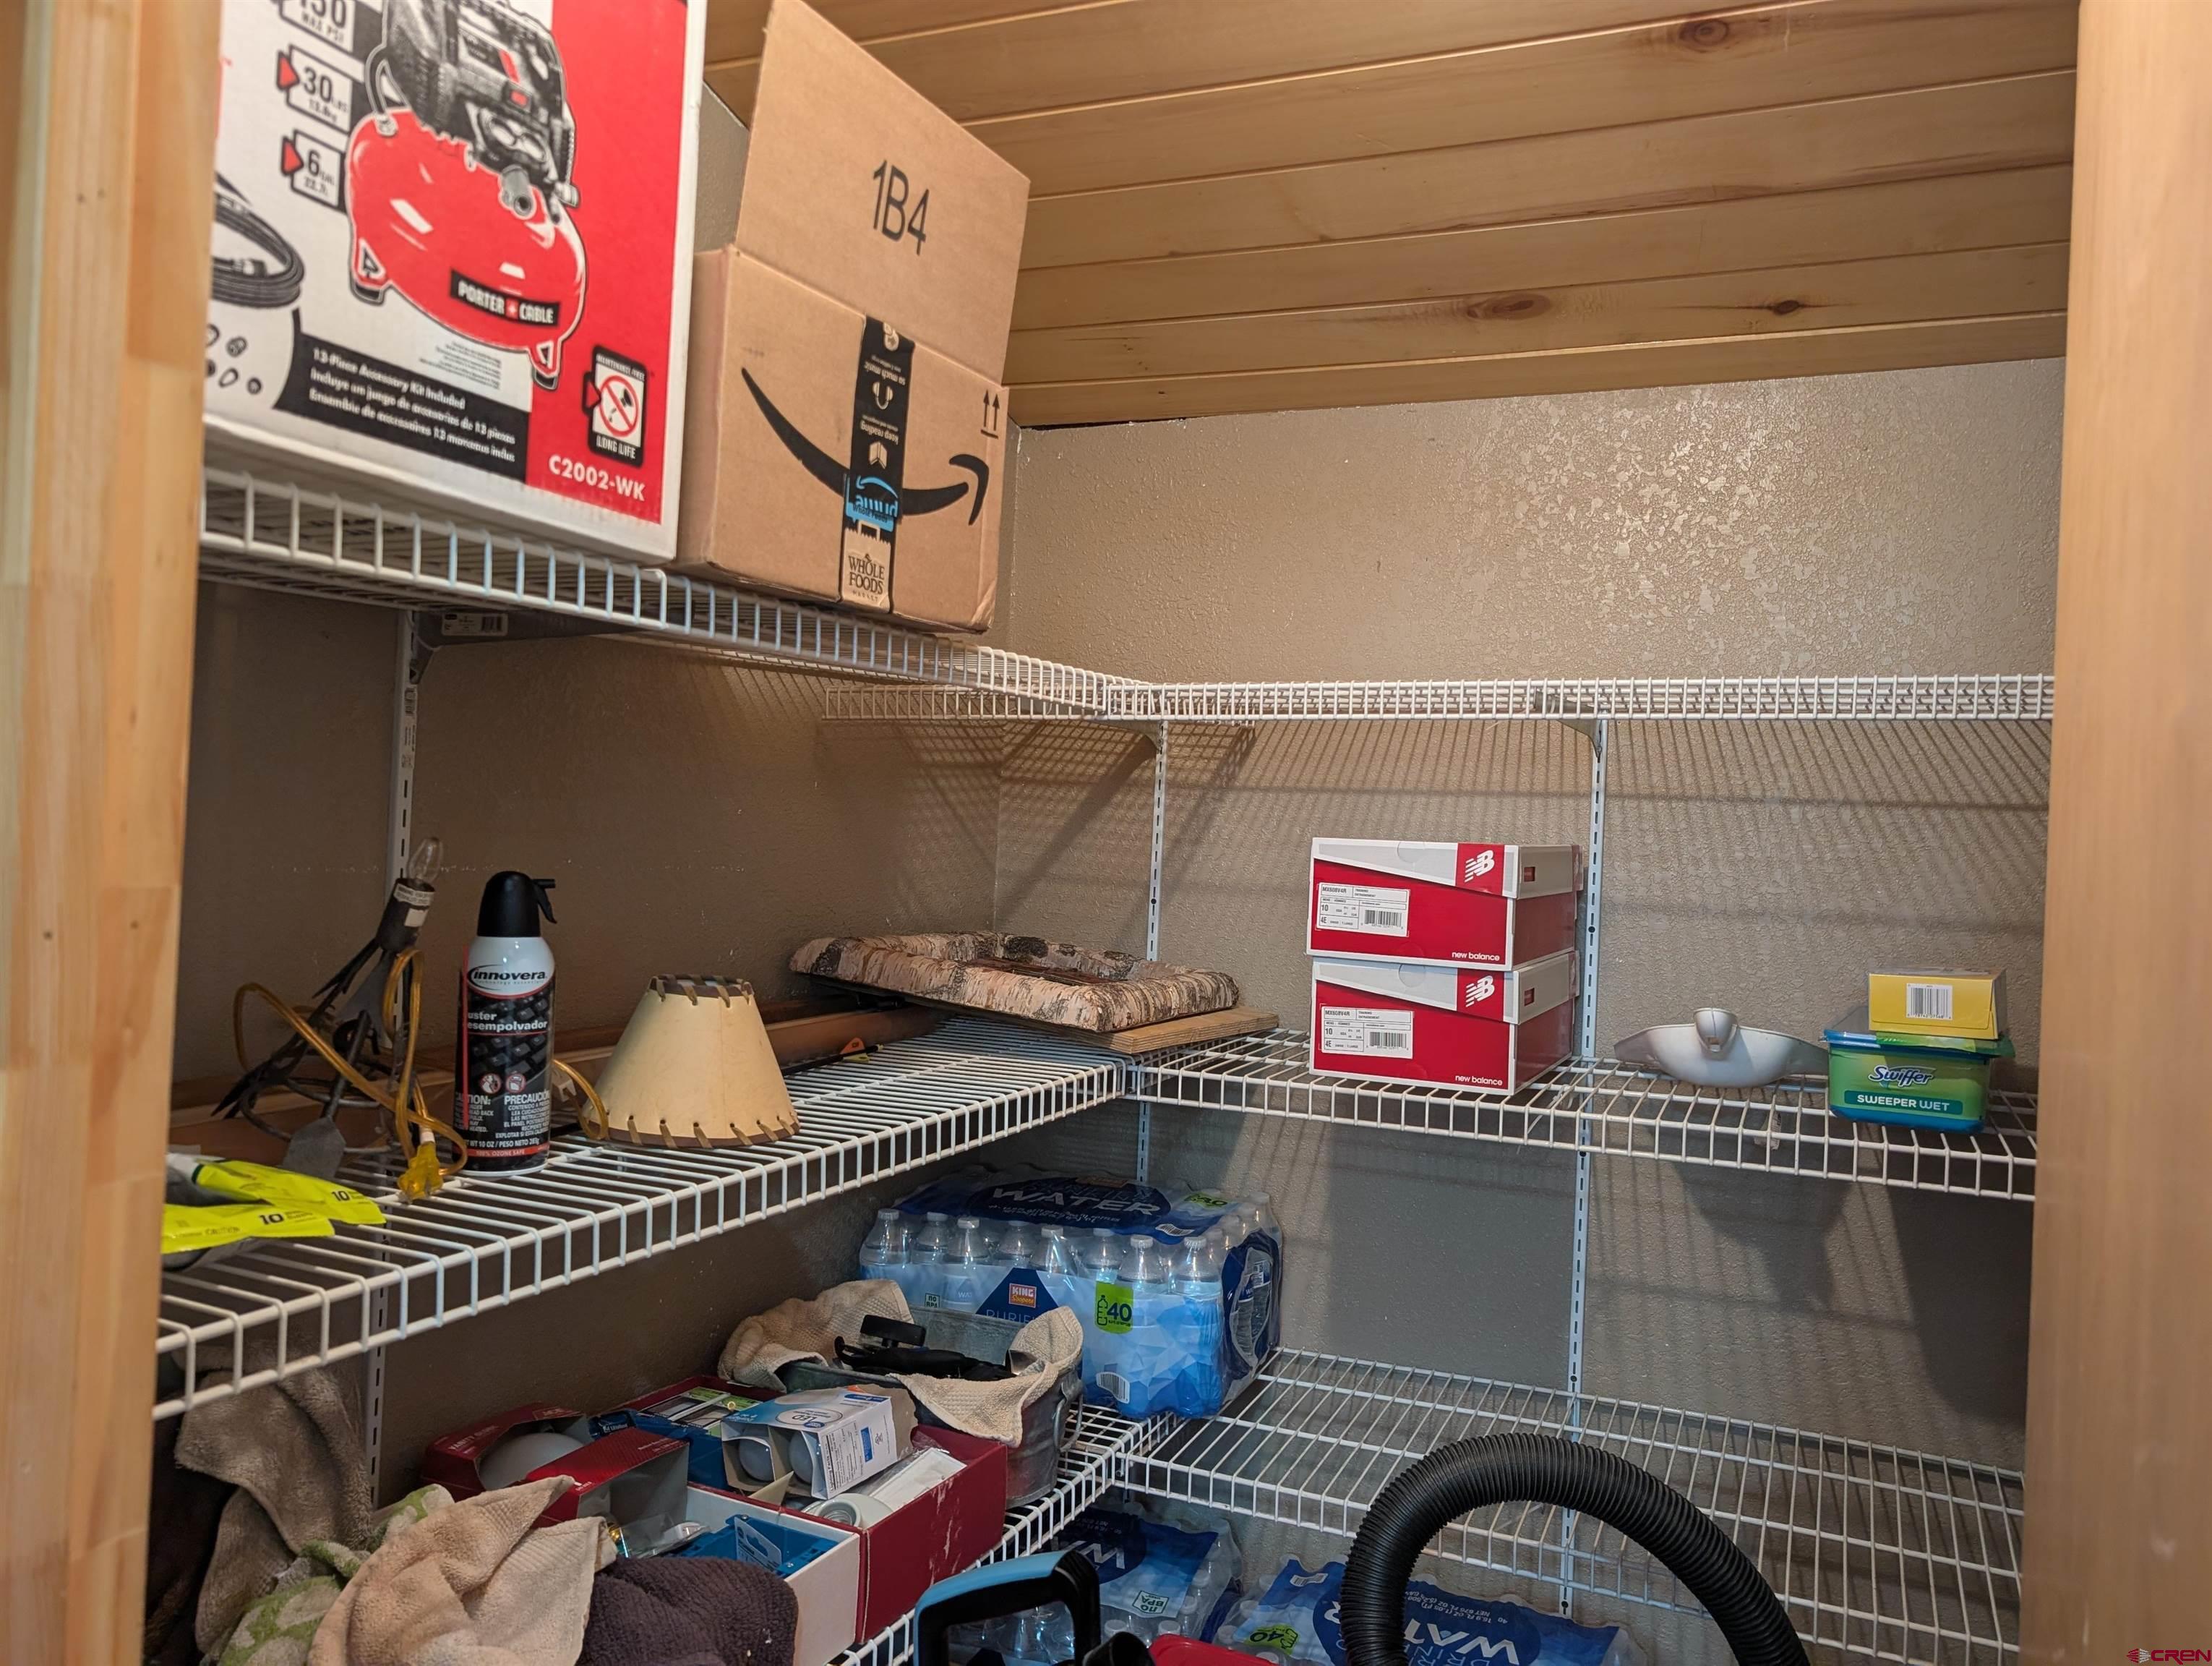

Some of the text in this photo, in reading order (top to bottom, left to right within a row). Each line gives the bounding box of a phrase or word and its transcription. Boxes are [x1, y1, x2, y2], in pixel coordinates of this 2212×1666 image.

[304, 66, 332, 103] 30
[308, 149, 321, 176] 6
[873, 158, 930, 257] 1B4
[458, 280, 554, 324] PORTER CABLE
[864, 361, 880, 375] music
[880, 367, 899, 383] much
[359, 363, 409, 393] Accessory
[409, 380, 425, 396] Kit
[425, 385, 466, 410] Included
[310, 366, 350, 391] Incluye
[351, 383, 366, 396] un
[366, 384, 396, 406] juego
[397, 396, 411, 411] de
[460, 416, 473, 430] de
[475, 421, 486, 435] 13
[486, 427, 515, 445] piezas
[309, 388, 361, 414] Ensemble
[361, 403, 376, 419] de
[434, 425, 446, 440] 13
[490, 444, 515, 462] inclus
[860, 419, 885, 437] reading
[883, 429, 899, 445] keep
[596, 435, 636, 460] LONG LIFE
[548, 454, 646, 502] C2002-WK
[848, 554, 885, 581] WHOLE
[849, 572, 883, 595] FOODS
[1468, 952, 1500, 961] balance
[473, 969, 546, 981] innovera
[467, 1012, 497, 1021] uster
[467, 1020, 548, 1033] esempolvador
[1471, 1075, 1503, 1086] balance
[1868, 1065, 1934, 1088] Swiffer
[1856, 1094, 1950, 1111] SWEEPER WET
[499, 1139, 515, 1148] PESO
[332, 1190, 351, 1201] 10
[993, 1188, 1161, 1216] WATER
[259, 1213, 285, 1226] 10
[1012, 1286, 1034, 1298] KING
[1107, 1302, 1132, 1322] 40
[1141, 1594, 1165, 1608] BPA
[1141, 1603, 1157, 1613] no
[1421, 1601, 1433, 1610] PT)
[1475, 1615, 1492, 1624] 16.9
[1249, 1631, 1284, 1643] 40
